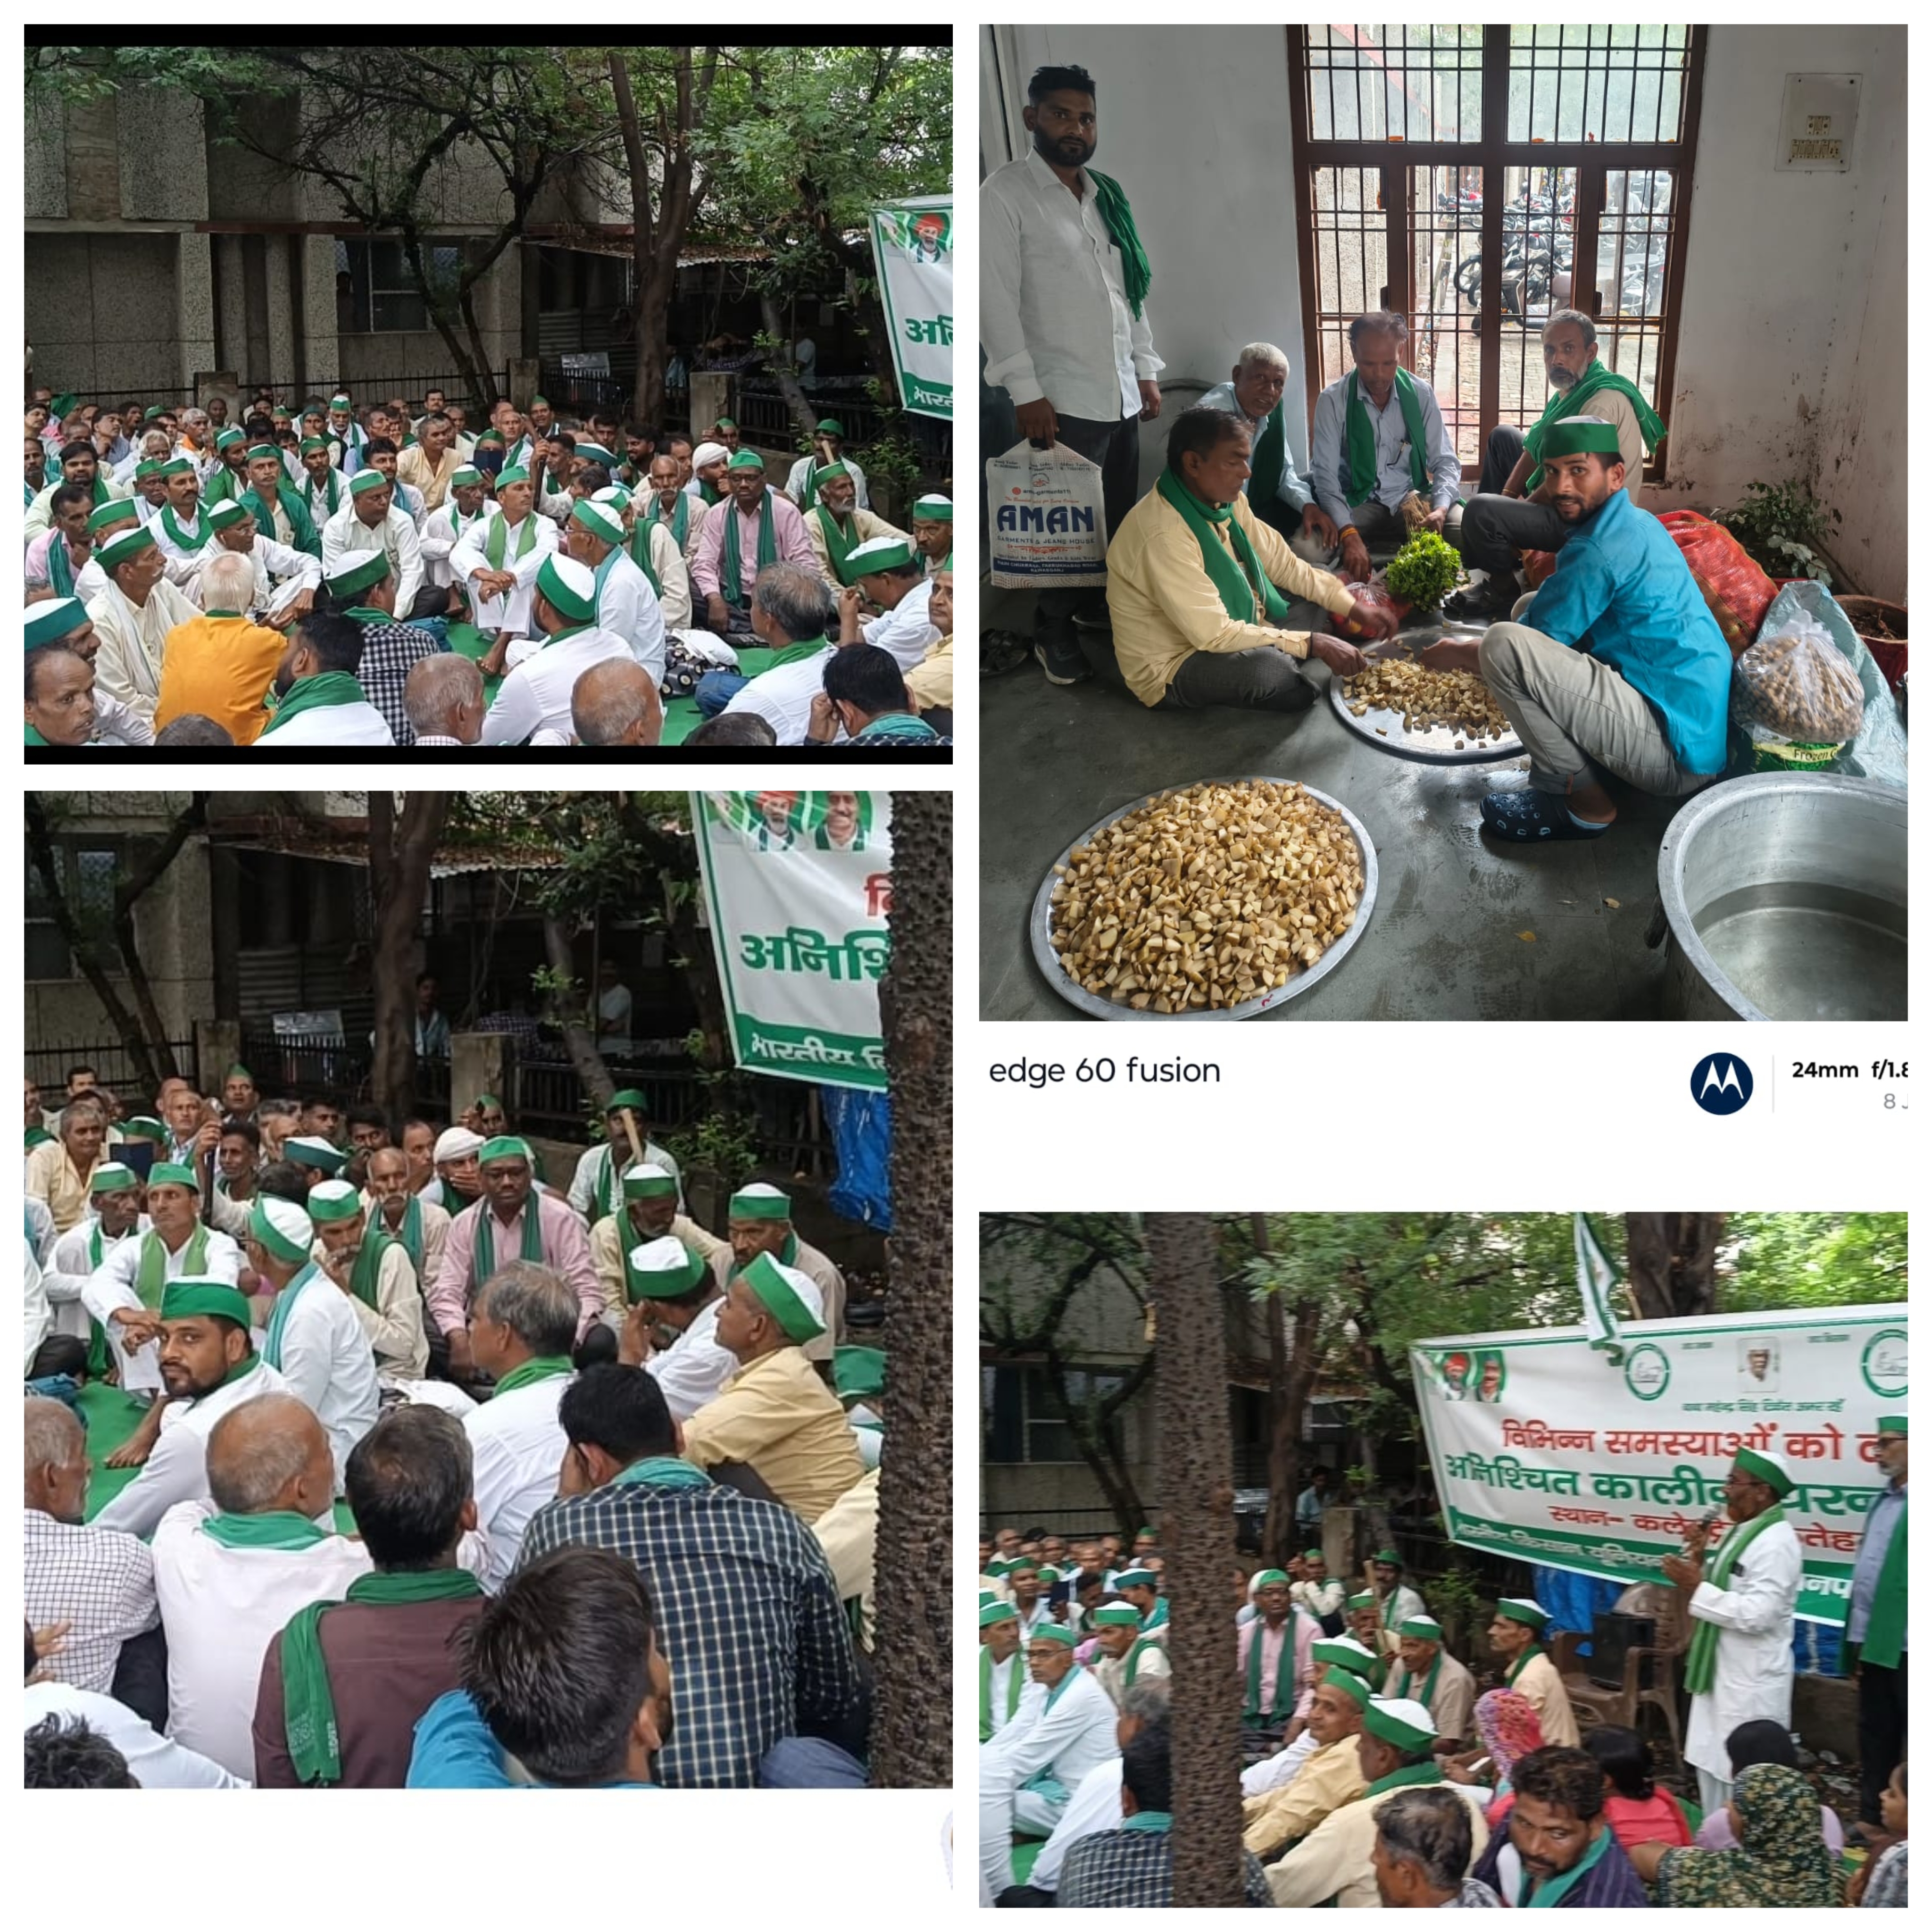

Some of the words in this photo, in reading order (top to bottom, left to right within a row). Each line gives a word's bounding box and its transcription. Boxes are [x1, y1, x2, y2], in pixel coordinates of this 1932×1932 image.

[997, 505, 1094, 535] AMAN
[1794, 749, 1828, 761] Frozen
[752, 1033, 856, 1064] भारतीय
[1502, 1419, 1596, 1452] विभिन्न
[1605, 1422, 1778, 1456] समस्याओं
[1783, 1423, 1843, 1459] को
[1445, 1452, 1580, 1496] अनिश्चित
